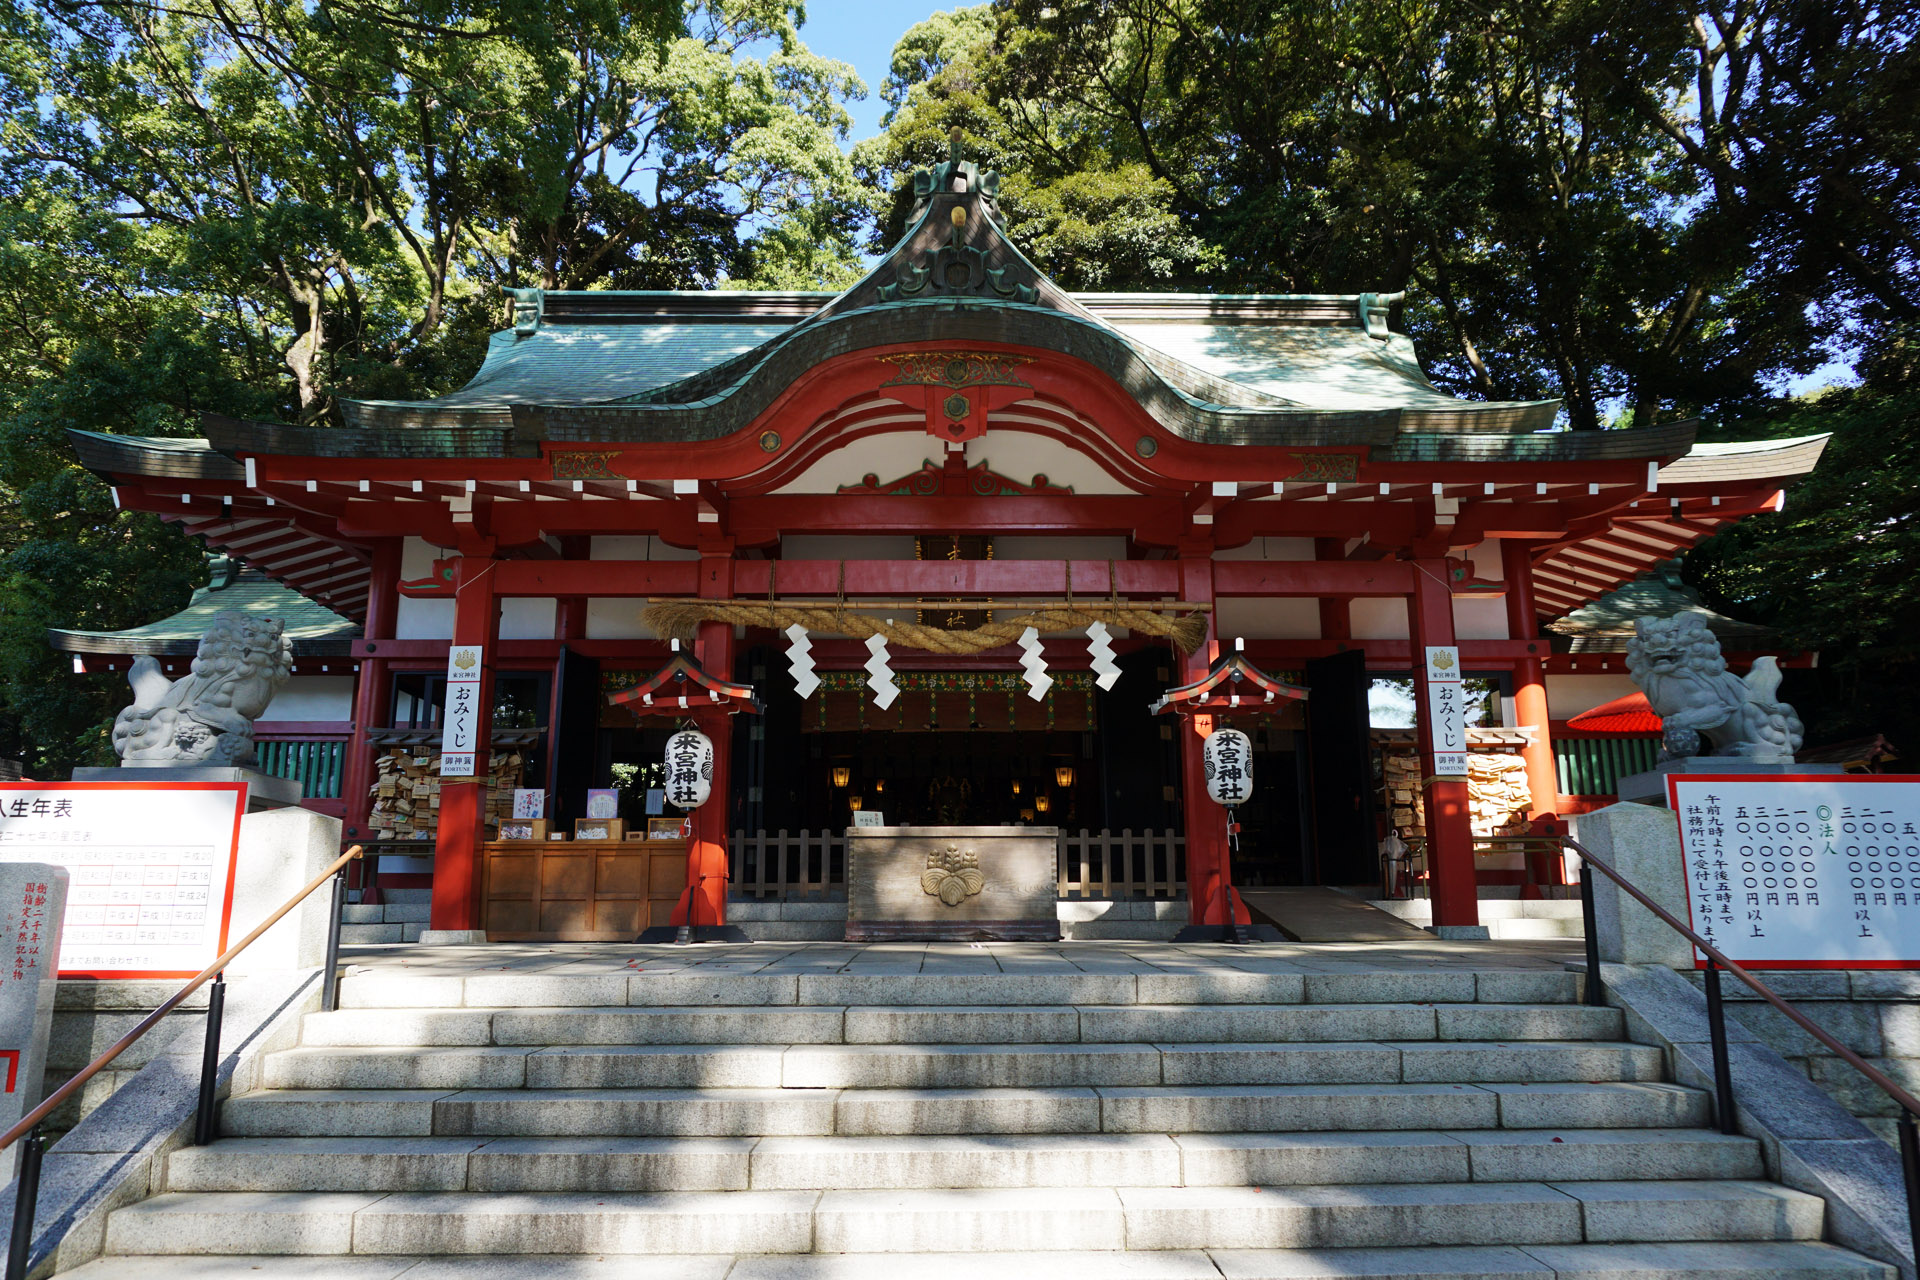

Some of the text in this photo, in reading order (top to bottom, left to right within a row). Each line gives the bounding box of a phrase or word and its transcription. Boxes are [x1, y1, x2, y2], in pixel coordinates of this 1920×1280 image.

[453, 687, 471, 748] おみくじ
[1439, 687, 1457, 747] おみくじ
[672, 733, 702, 803] 来宮神社
[1215, 731, 1243, 800] 来宮神社
[180, 872, 209, 880] 平成18
[1704, 794, 1735, 925] 午前九時より午後五時まで
[175, 911, 204, 920] 平成22
[178, 891, 206, 900] 平成24
